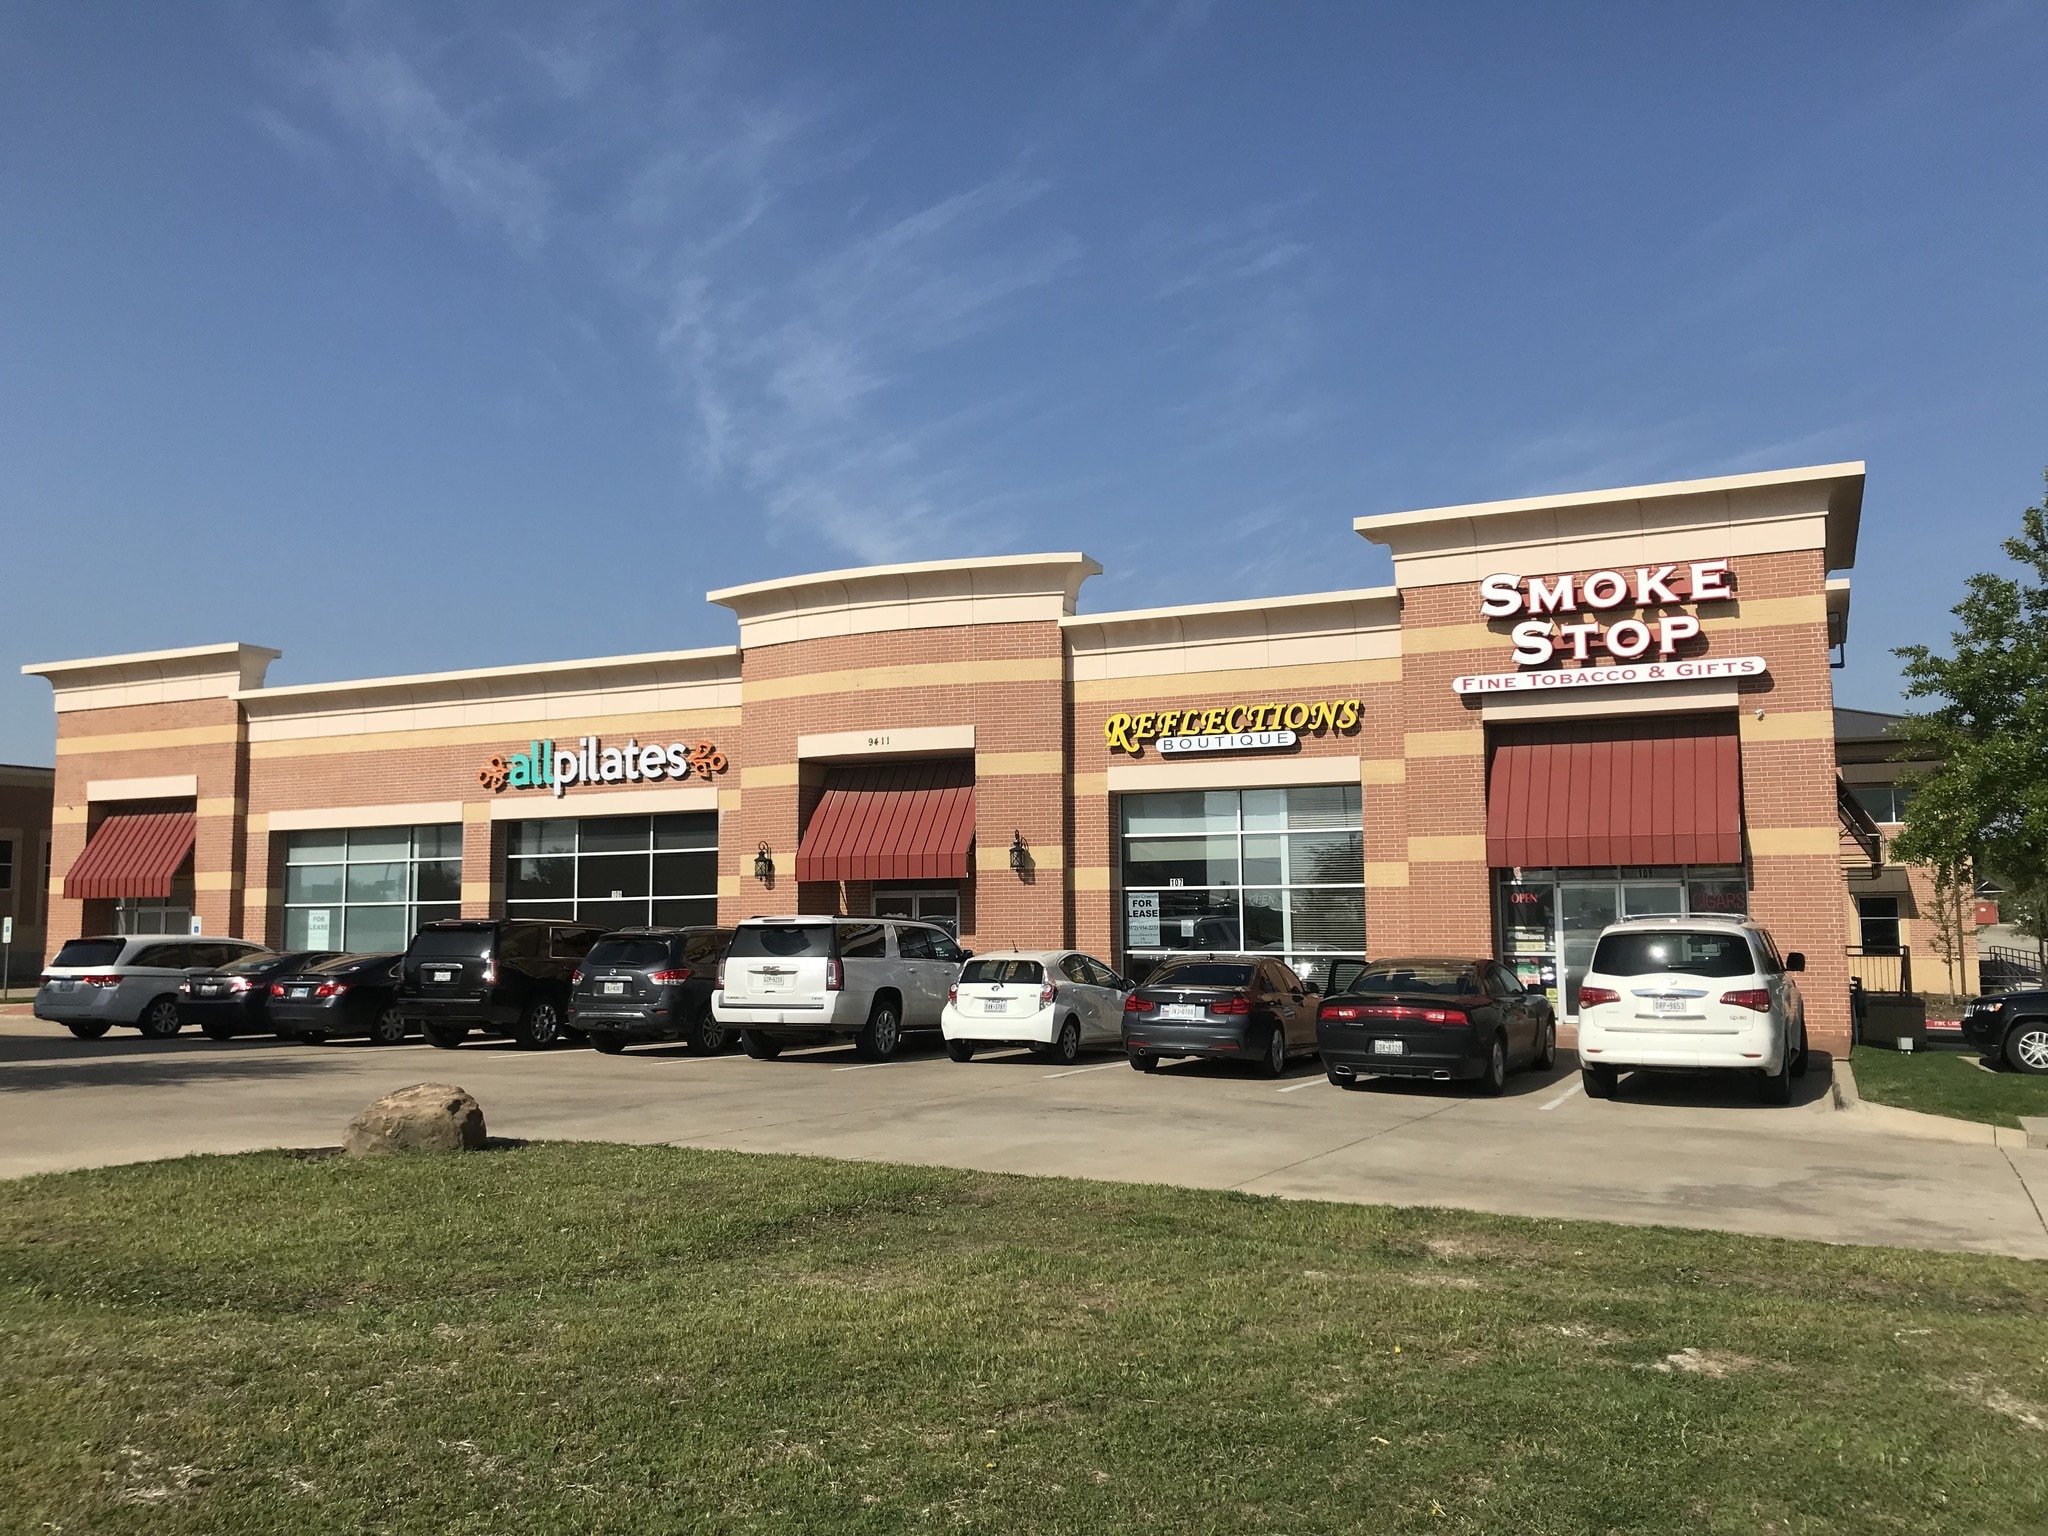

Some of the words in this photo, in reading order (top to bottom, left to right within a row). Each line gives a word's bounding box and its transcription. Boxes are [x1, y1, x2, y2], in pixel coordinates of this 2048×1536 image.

[1480, 558, 1732, 617] SMOKE
[1511, 615, 1700, 665] STOP
[1462, 677, 1516, 690] FINE
[1527, 669, 1637, 688] TOBACCO
[1648, 665, 1665, 678] &
[1676, 660, 1755, 676] GIFTS
[1104, 699, 1360, 753] REFLECTIONS
[868, 736, 890, 746] 9411
[1163, 731, 1290, 750] BOUTIQUE
[1170, 879, 1183, 887] 107
[1249, 894, 1275, 905] OPEN
[1511, 893, 1538, 904] OPEN
[1692, 892, 1746, 909] CIGARS
[1128, 910, 1158, 918] LEASE
